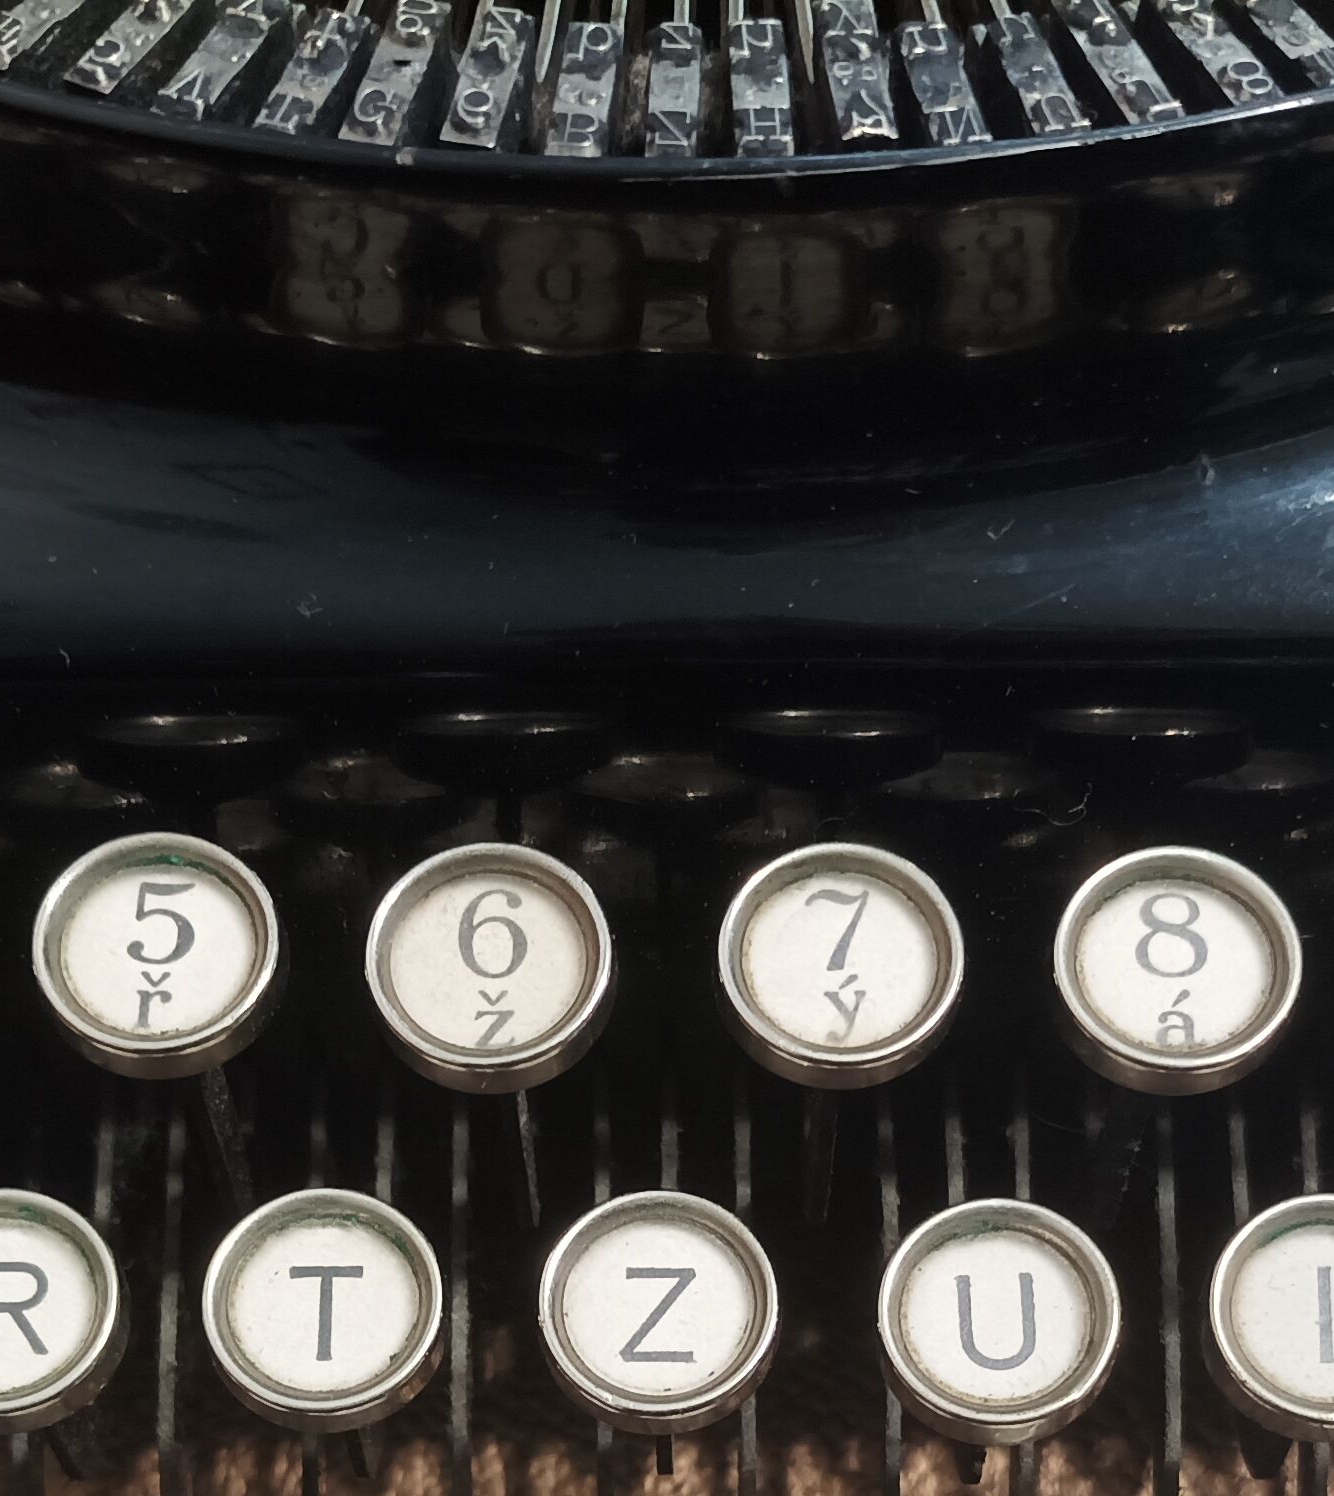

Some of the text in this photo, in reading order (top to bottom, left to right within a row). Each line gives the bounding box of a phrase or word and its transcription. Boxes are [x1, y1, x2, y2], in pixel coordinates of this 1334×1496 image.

[126, 882, 196, 964] 5
[458, 889, 527, 978] 6
[804, 889, 870, 971] 7
[1135, 893, 1208, 977] 8
[136, 971, 171, 1028] ř
[474, 989, 515, 1046] ž
[824, 974, 866, 1043] ý
[1156, 989, 1195, 1044] á
[289, 1265, 364, 1362] T
[620, 1267, 697, 1363] Z
[953, 1272, 1036, 1371] U
[1316, 1266, 1334, 1364] I
